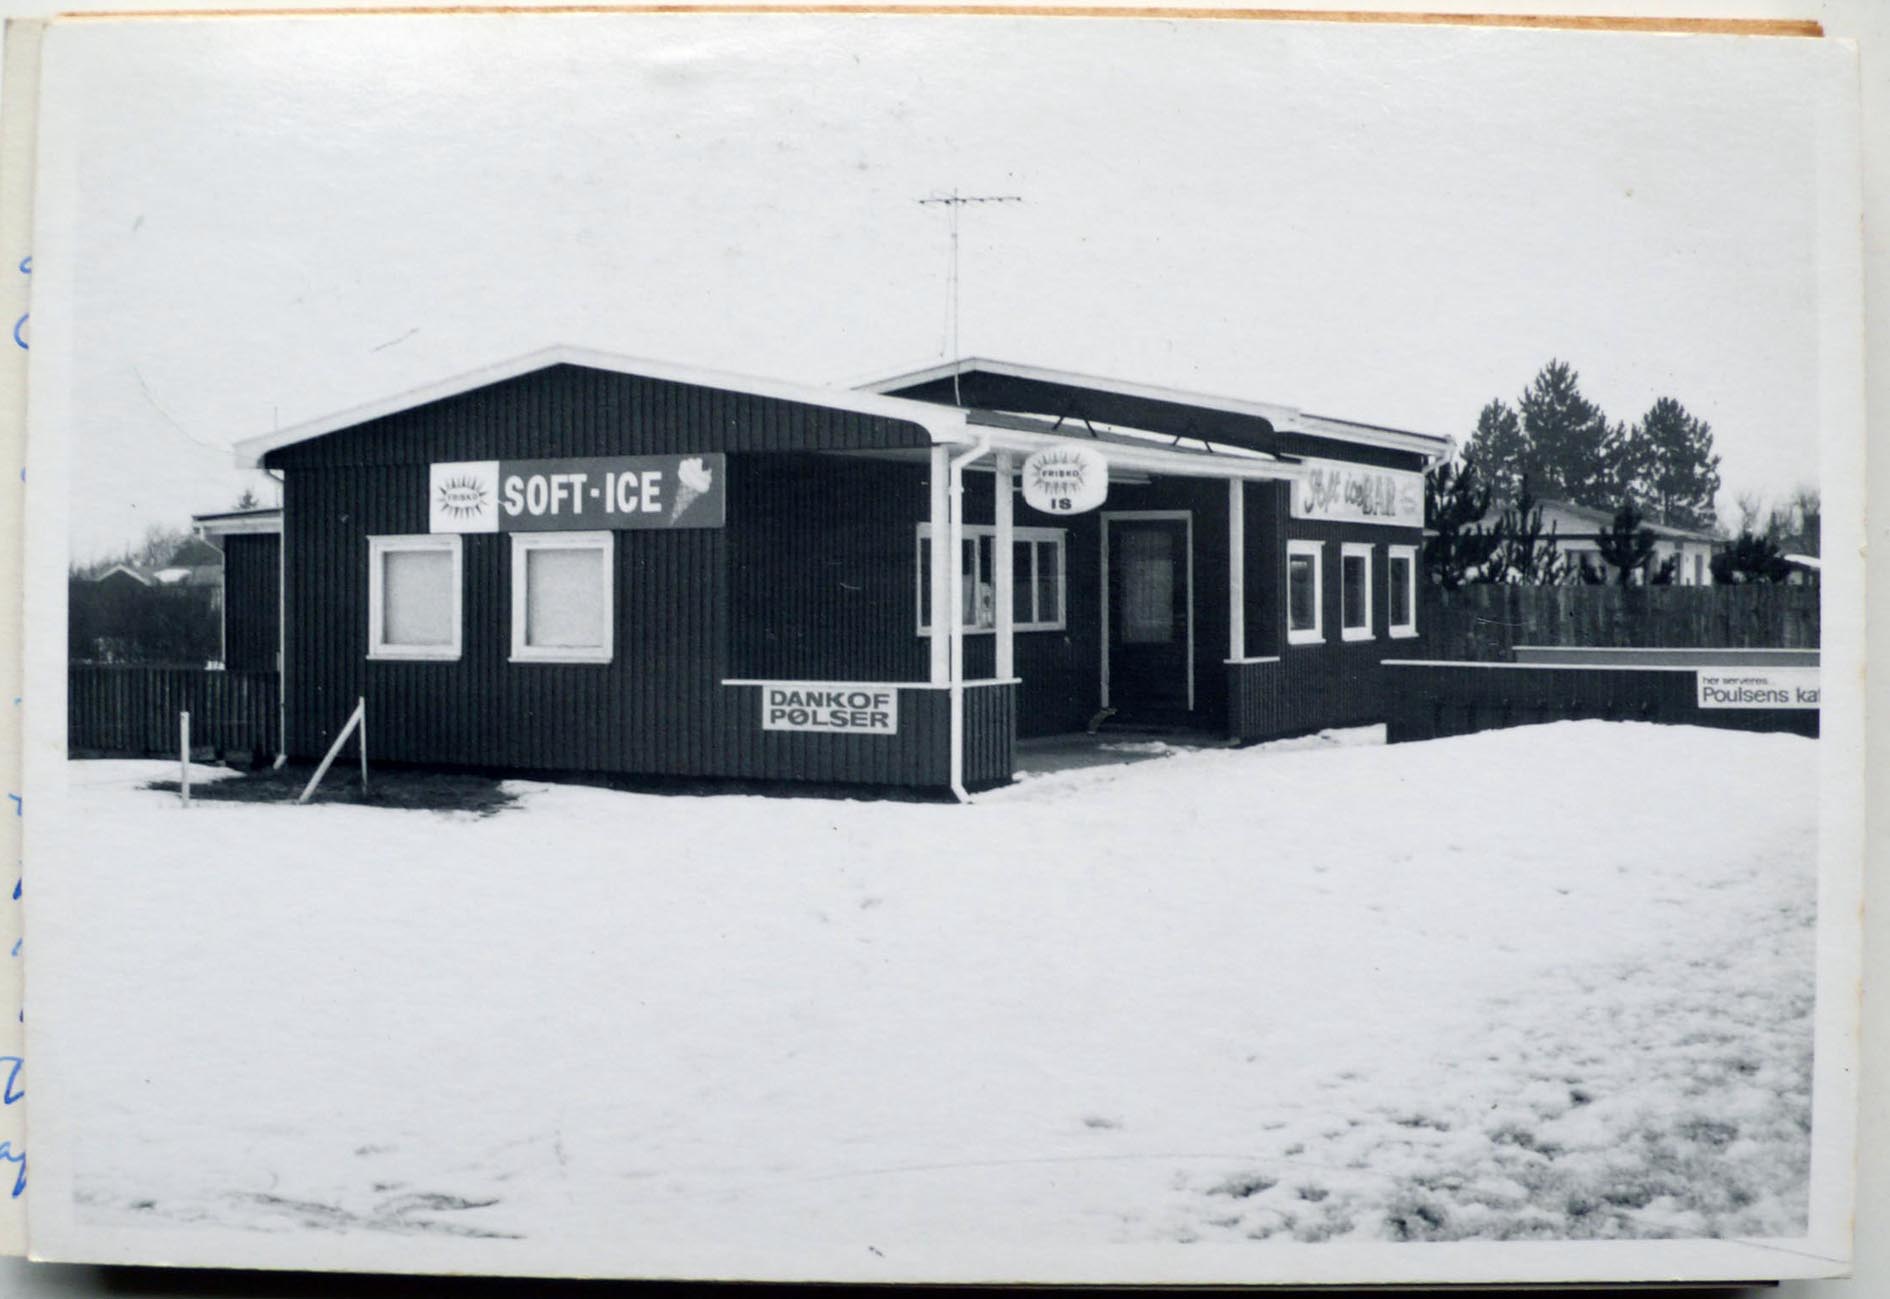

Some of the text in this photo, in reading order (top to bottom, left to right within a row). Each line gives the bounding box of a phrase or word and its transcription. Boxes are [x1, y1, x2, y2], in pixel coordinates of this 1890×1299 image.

[1051, 498, 1072, 510] IS
[770, 690, 890, 709] DANKOF
[1703, 687, 1789, 703] Poulsens
[770, 708, 889, 728] PØLSER
